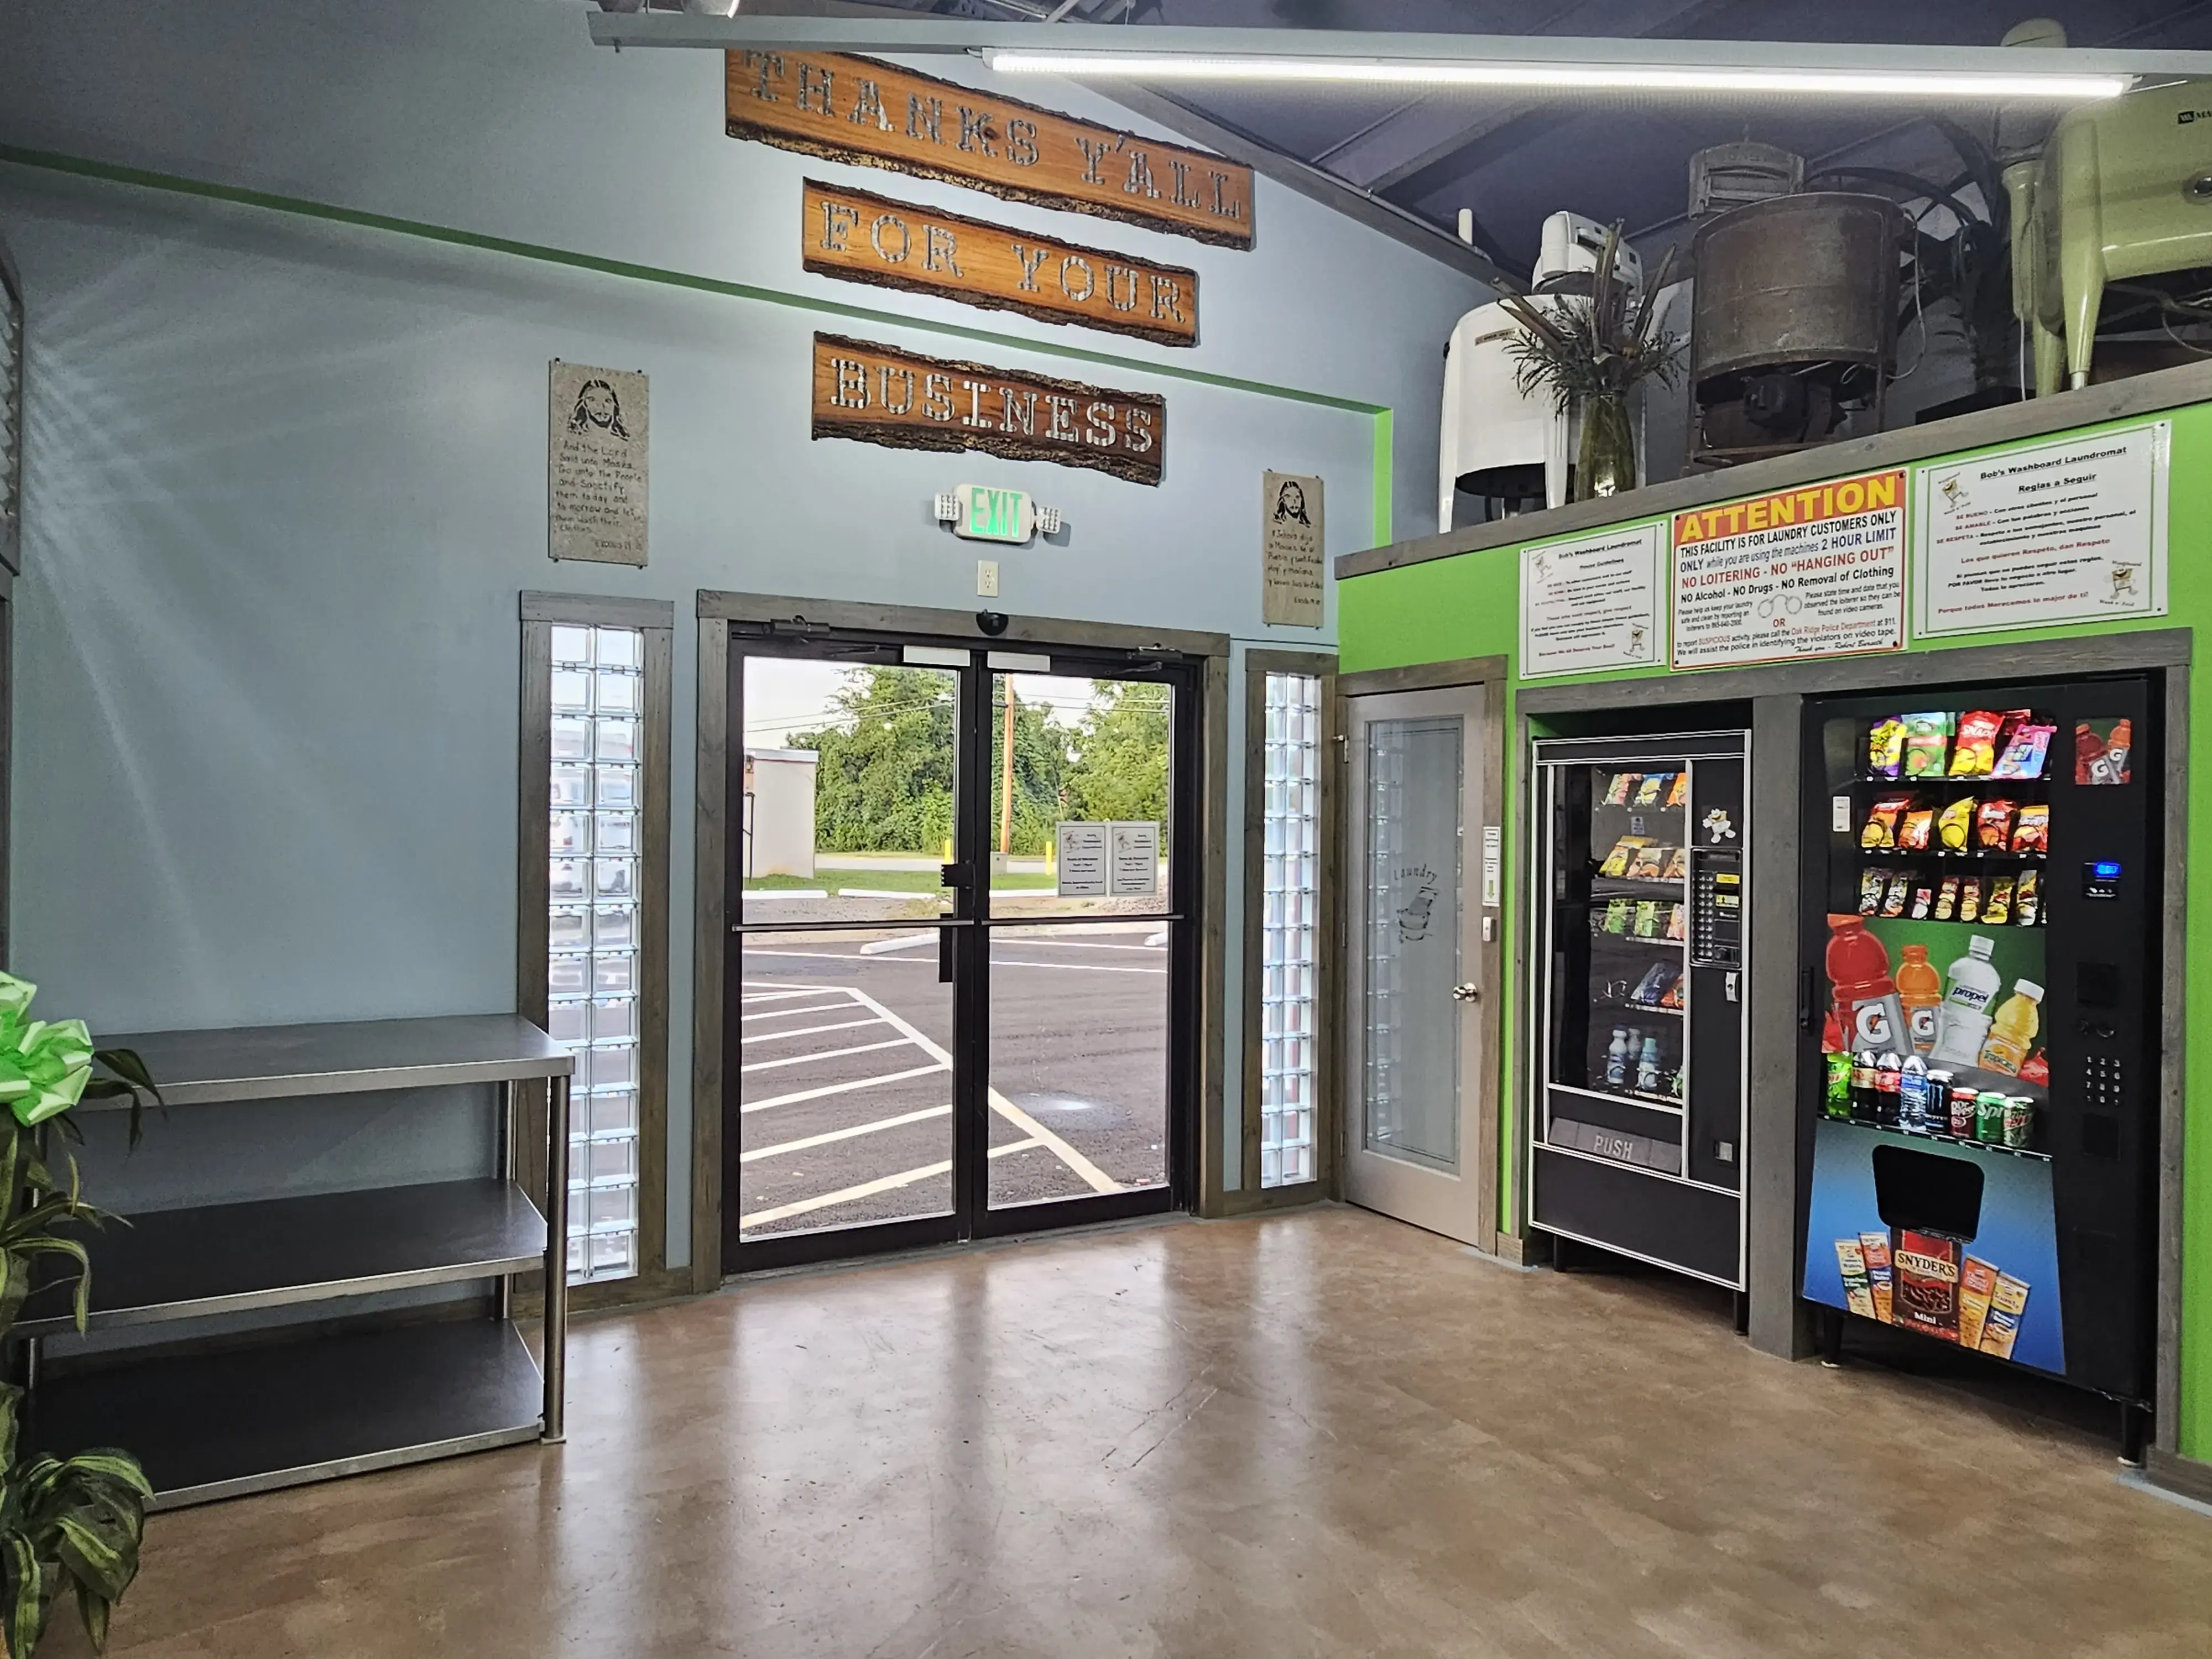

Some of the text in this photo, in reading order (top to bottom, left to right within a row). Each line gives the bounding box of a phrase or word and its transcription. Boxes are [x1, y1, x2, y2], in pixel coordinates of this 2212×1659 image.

[744, 49, 1240, 220] THANKS Y'ALL
[820, 201, 1186, 323] FOR YOUR
[830, 357, 1152, 452] BUSINESS
[1980, 446, 2127, 480] Bob's Washboard Laundromat
[2018, 482, 2051, 493] Reglas
[2063, 473, 2097, 485] Seguir
[969, 487, 1022, 538] EXIT
[1681, 475, 1895, 542] ATTENTION
[1680, 510, 1897, 558] THIS FACILITY IS FOR LAUNDRY CUSTOMERS ONLY
[1680, 526, 1896, 573] ONLY while you are using the machines 2 HOUR LIMIT
[1681, 565, 1894, 604] NO Alcohol NO Drugs NO Removal of Clothing
[1682, 576, 1697, 589] NO
[1700, 566, 1760, 587] LOITERING
[1770, 562, 1788, 576] NO
[1772, 617, 1786, 628] OR
[1699, 645, 1718, 654] assist
[1730, 642, 1750, 652] police
[1759, 638, 1796, 648] identifying
[1810, 634, 1841, 642] violators
[1854, 630, 1876, 638] video
[2110, 748, 2123, 761] G
[2091, 759, 2109, 777] G
[1394, 864, 1437, 885] Laundry
[1953, 986, 1989, 1004] propel
[1856, 1003, 1892, 1044] G
[1911, 1010, 1934, 1036] G
[1593, 1134, 1634, 1159] PUSH
[1897, 1253, 1955, 1276] SNYDER'S
[1914, 1312, 1937, 1324] Mini
